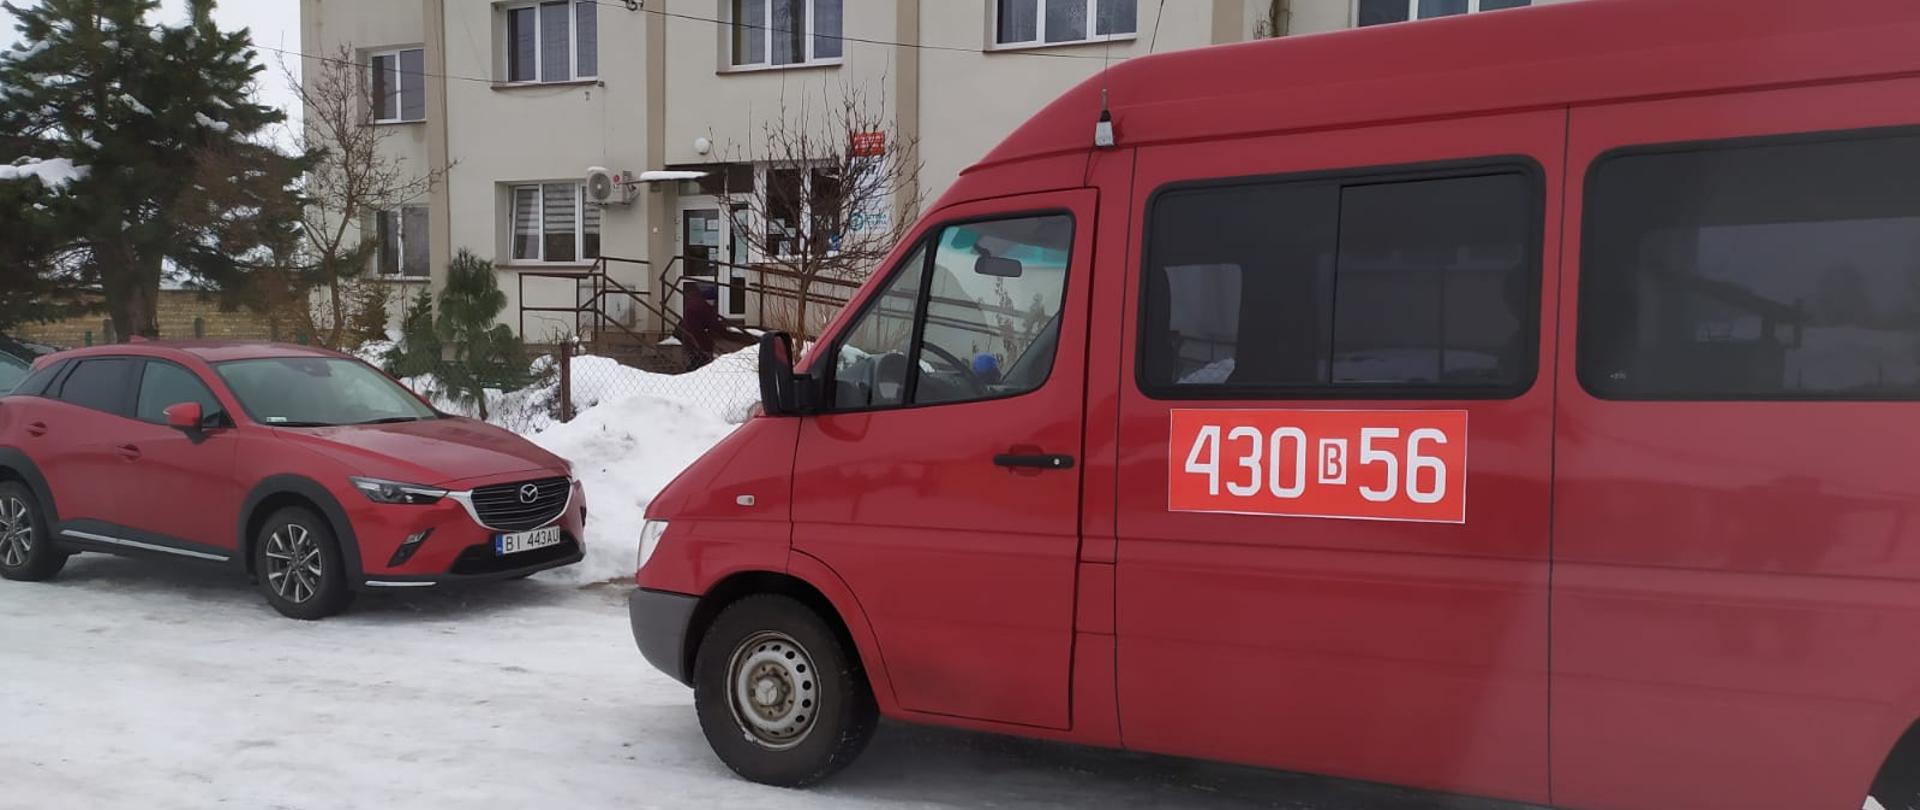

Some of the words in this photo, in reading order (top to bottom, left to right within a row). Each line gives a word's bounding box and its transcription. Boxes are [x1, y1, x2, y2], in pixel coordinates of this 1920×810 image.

[1185, 425, 1306, 498] 430
[1322, 442, 1343, 481] B
[1359, 427, 1447, 503] 56
[506, 536, 520, 551] BI
[527, 529, 559, 546] 443AU
